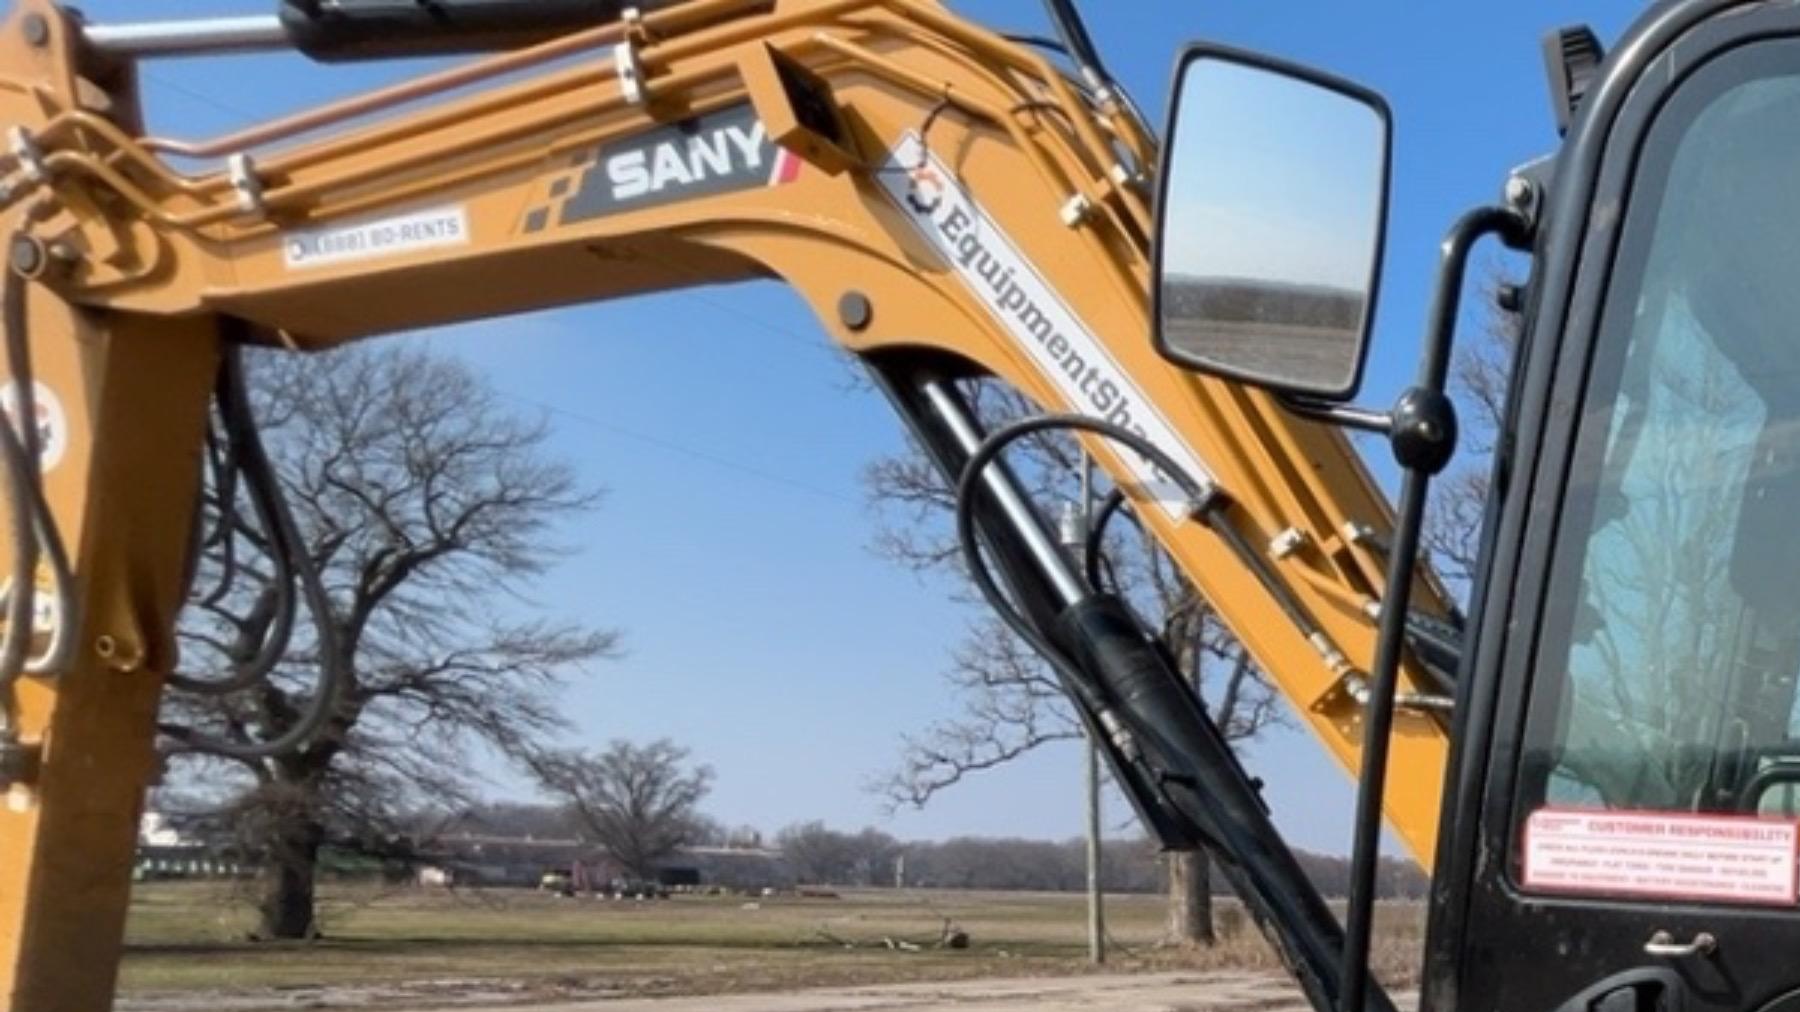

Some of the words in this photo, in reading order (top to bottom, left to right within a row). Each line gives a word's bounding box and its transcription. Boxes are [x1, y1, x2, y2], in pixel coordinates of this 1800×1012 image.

[606, 120, 767, 201] SANY
[1587, 820, 1666, 836] CUSTOMER
[1669, 823, 1791, 842] RESPONSIBILITY
